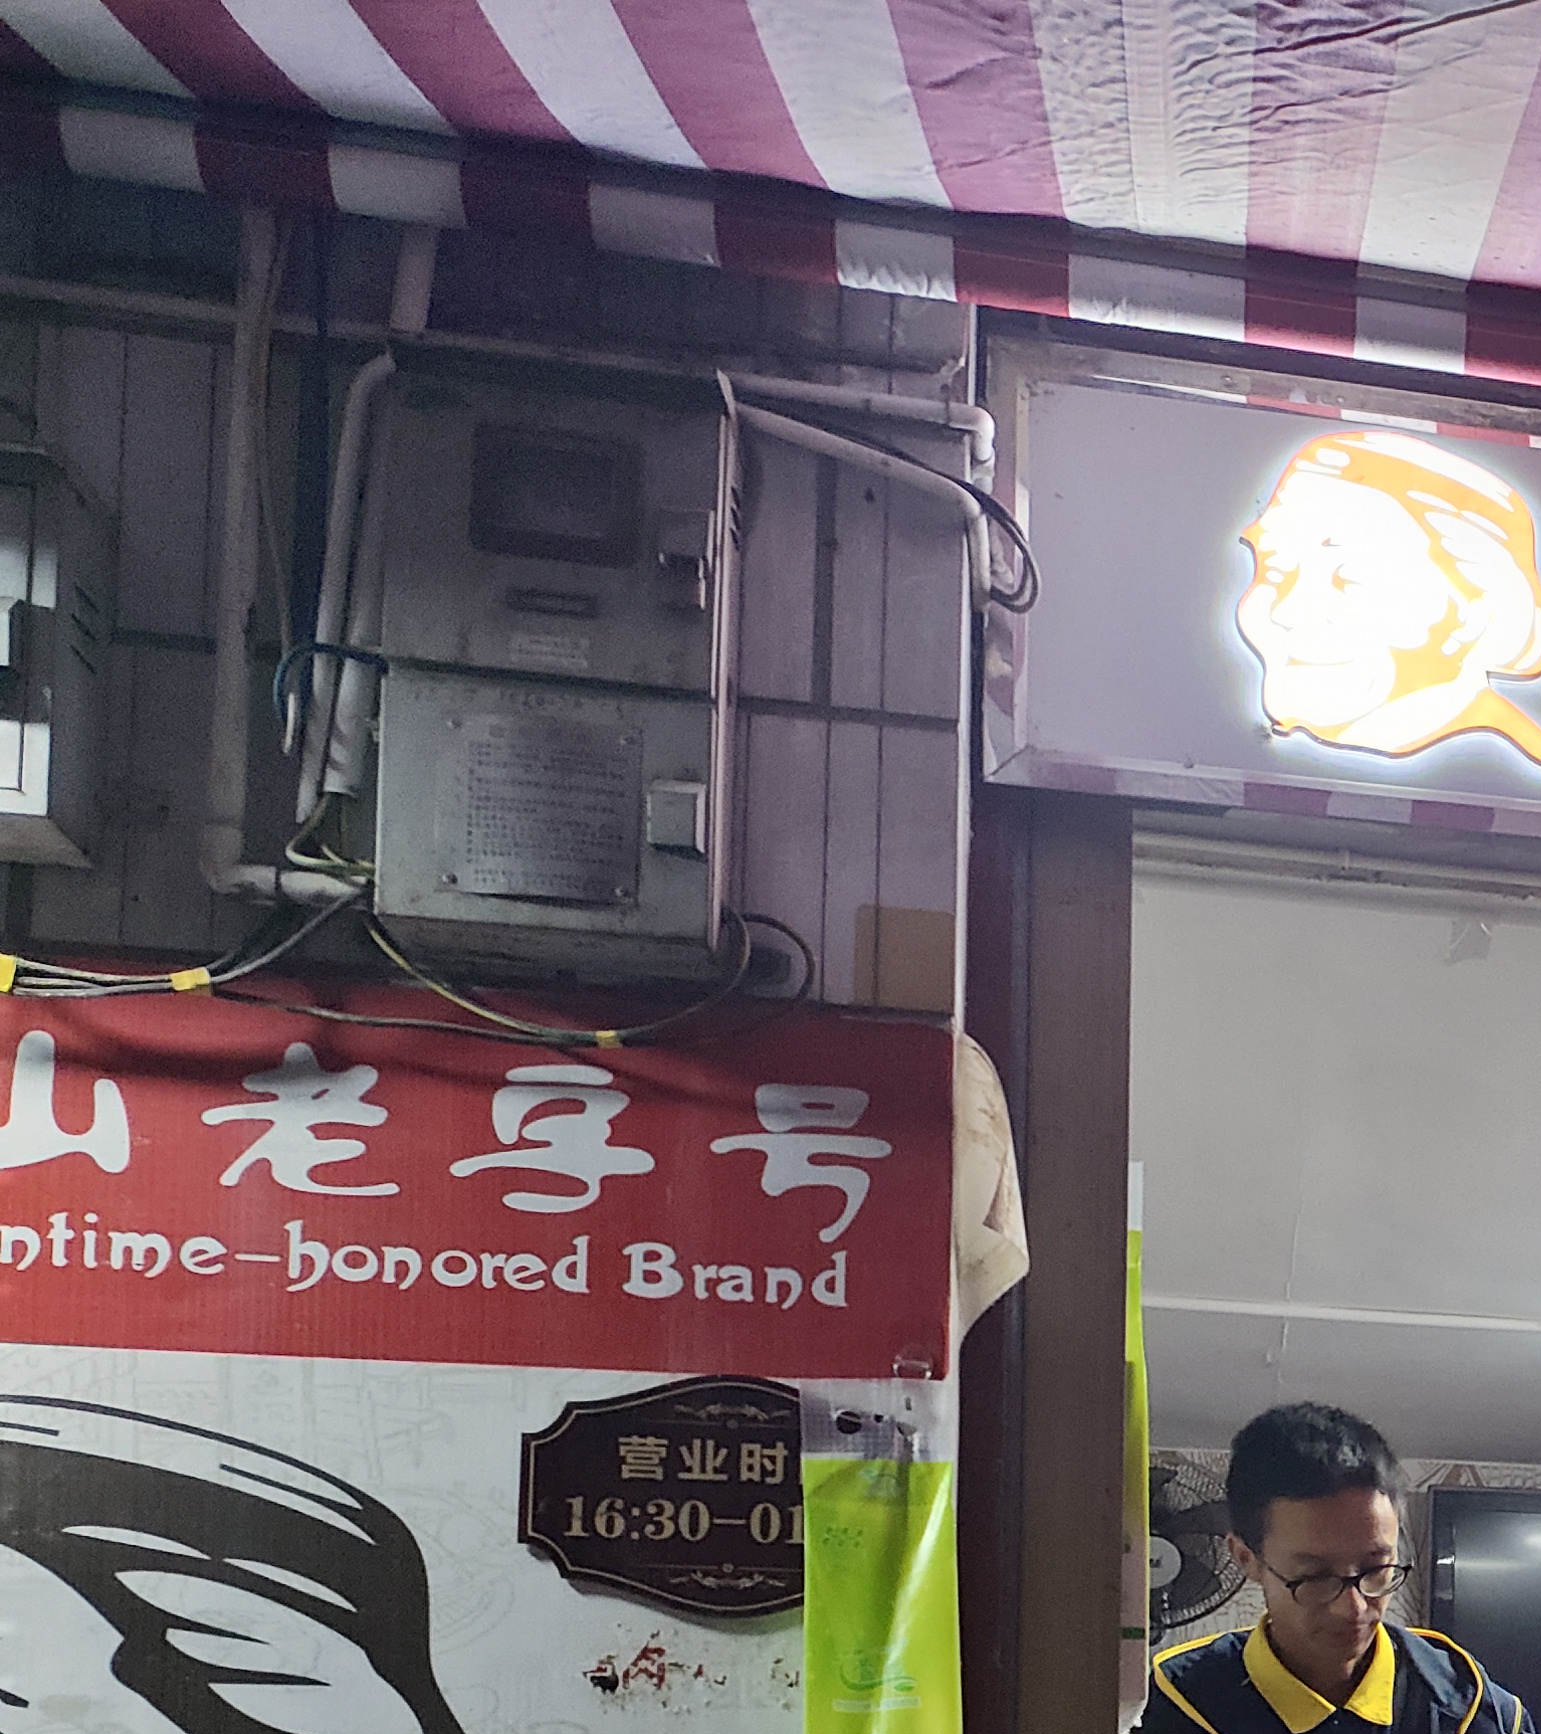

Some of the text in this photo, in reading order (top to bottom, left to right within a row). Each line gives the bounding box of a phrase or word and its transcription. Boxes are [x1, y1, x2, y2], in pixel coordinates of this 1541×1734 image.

[623, 1241, 848, 1309] Brand
[617, 1435, 803, 1485] 营业时
